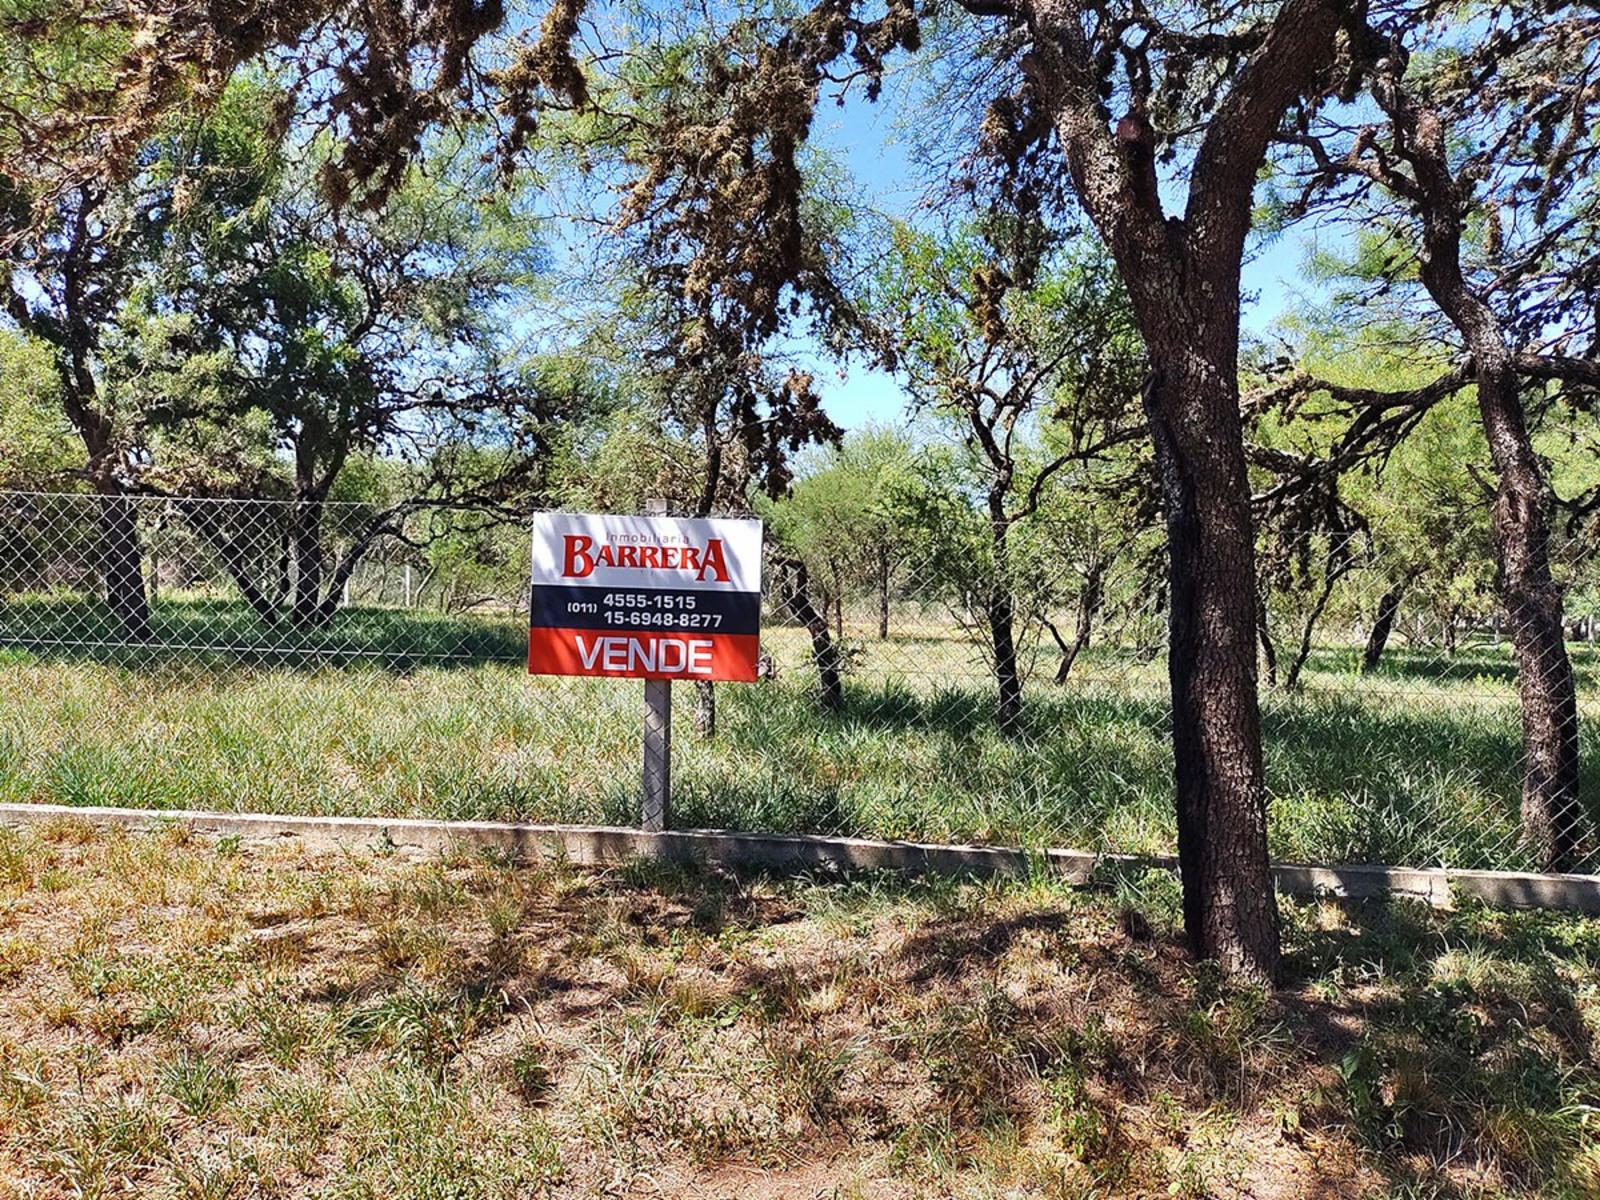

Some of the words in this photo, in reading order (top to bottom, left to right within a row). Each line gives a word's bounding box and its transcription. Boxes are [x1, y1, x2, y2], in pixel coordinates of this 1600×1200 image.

[606, 532, 689, 544] Inmobiliaria
[561, 535, 731, 582] BARRERA
[567, 602, 598, 614] (011)
[603, 594, 696, 609] 4555-1515
[603, 612, 722, 628] 15-6948-8277
[575, 635, 713, 674] VENDE
